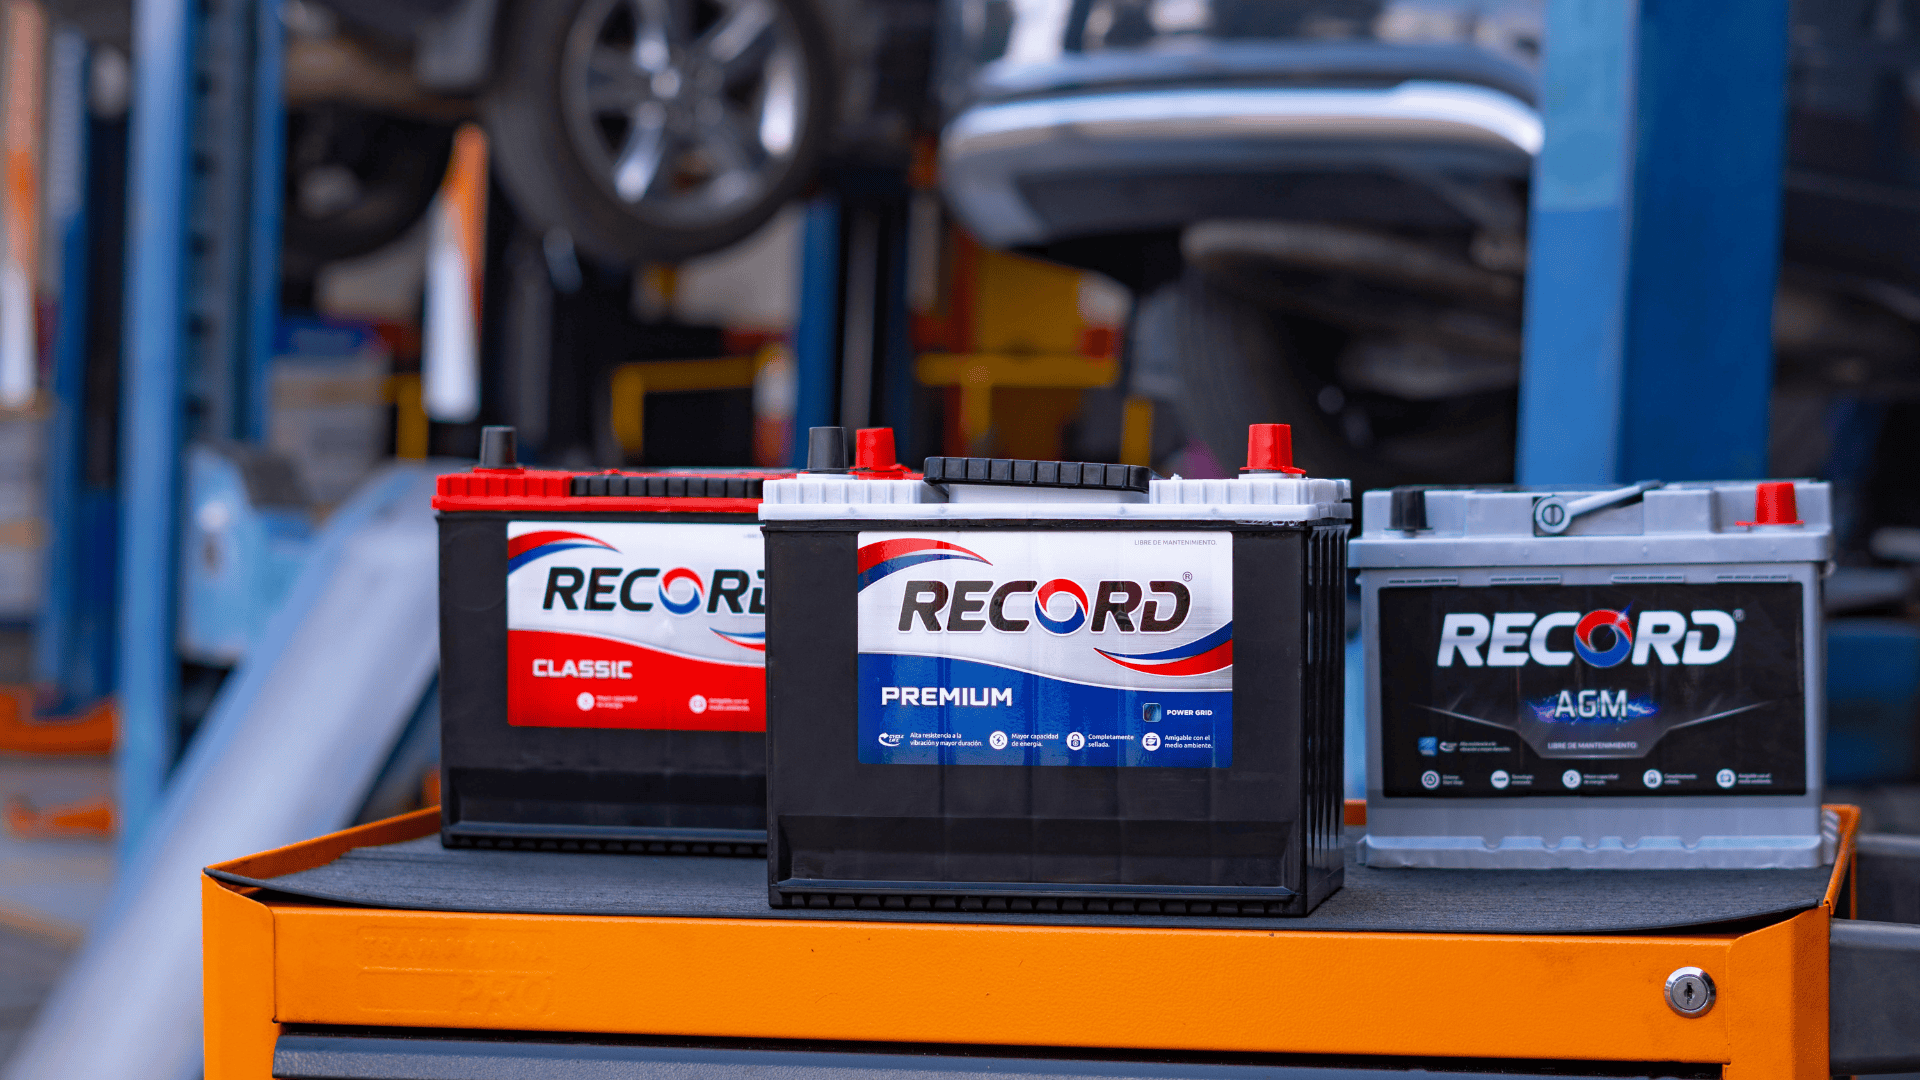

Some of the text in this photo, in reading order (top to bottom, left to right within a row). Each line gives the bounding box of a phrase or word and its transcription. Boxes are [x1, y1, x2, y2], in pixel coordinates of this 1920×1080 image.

[898, 578, 1192, 636] RECORD
[1437, 608, 1737, 668] RECORD
[532, 659, 633, 679] CLASSIC
[881, 686, 1013, 706] PREMIUM
[1554, 690, 1628, 718] AGM
[1031, 733, 1059, 741] capacidad
[1088, 733, 1135, 741] Completamente
[1164, 734, 1192, 742] Amigable
[1547, 741, 1570, 749] LIBRE
[1571, 741, 1578, 749] DE
